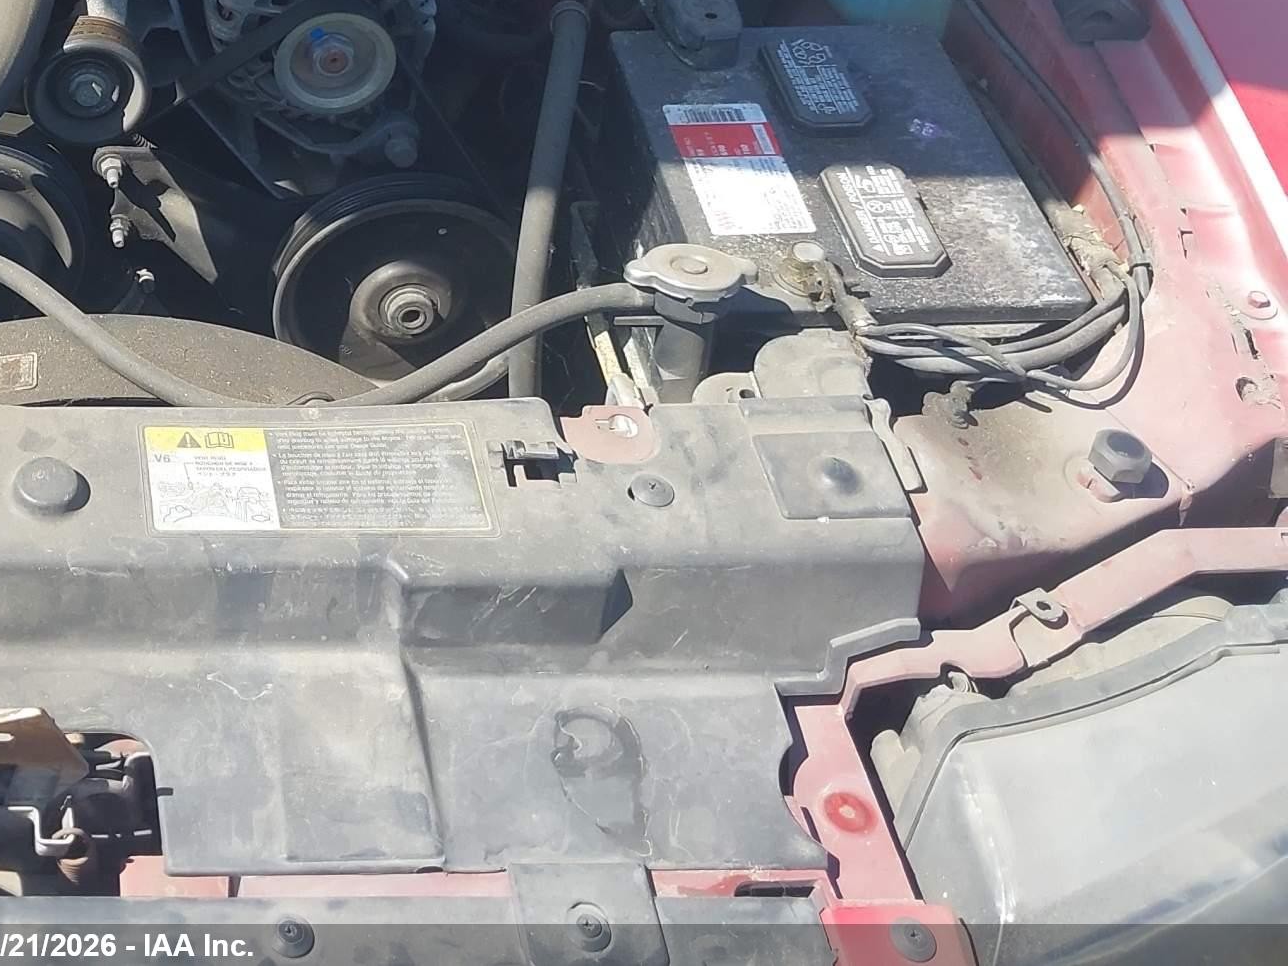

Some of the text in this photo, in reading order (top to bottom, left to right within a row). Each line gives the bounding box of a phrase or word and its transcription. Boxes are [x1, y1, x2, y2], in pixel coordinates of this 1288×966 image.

[835, 172, 860, 203] POISON
[855, 209, 881, 244] DANGER
[154, 454, 172, 464] V6
